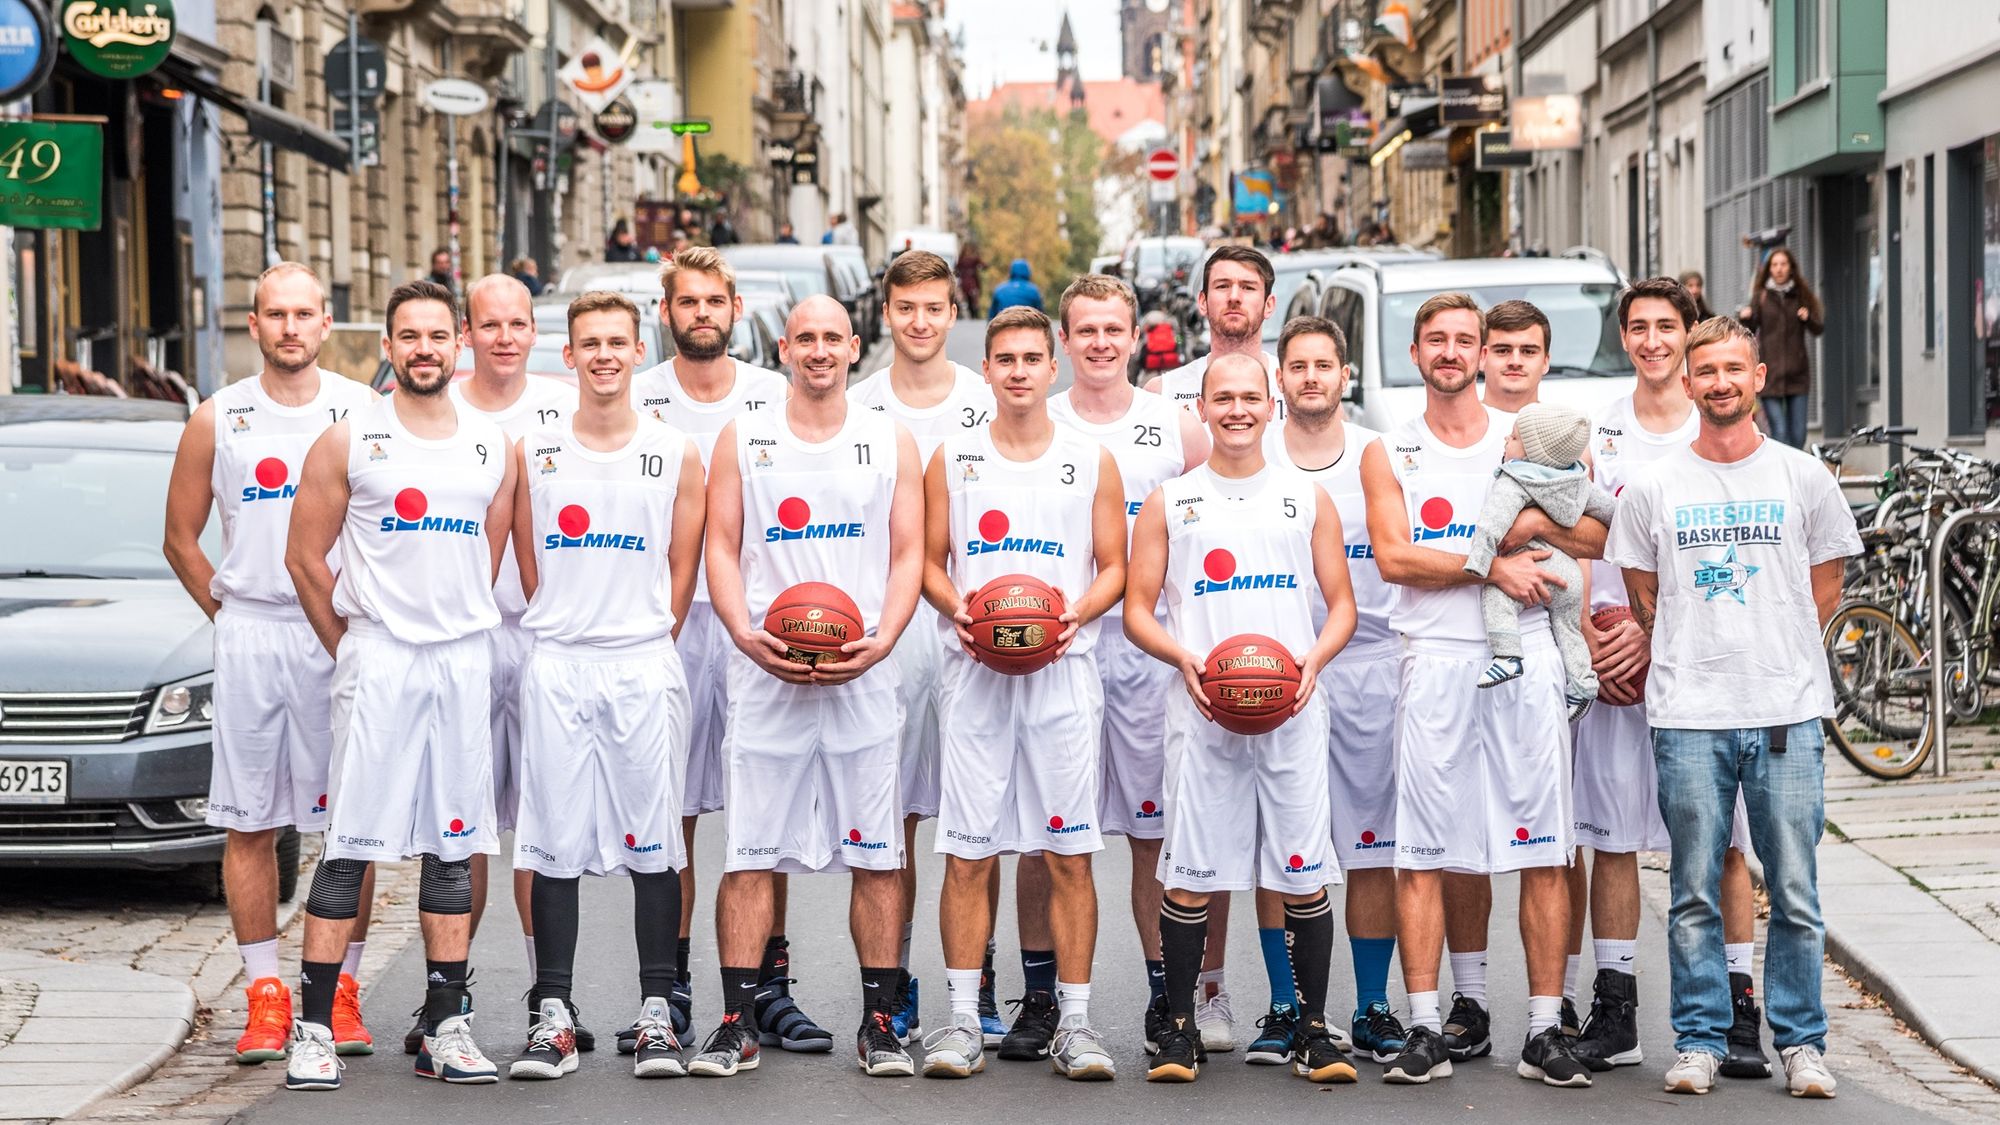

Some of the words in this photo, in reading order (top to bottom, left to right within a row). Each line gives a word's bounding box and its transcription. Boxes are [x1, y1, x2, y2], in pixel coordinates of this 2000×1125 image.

[64, 1, 171, 48] Carlsberg
[1133, 424, 1162, 447] 25
[475, 443, 488, 465] 9
[854, 443, 871, 465] 11
[639, 453, 663, 478] 10
[1060, 463, 1076, 485] 3
[1283, 497, 1297, 519] 5
[1675, 503, 1785, 529] DRESDEN
[1676, 525, 1782, 546] BASKETBALL
[1694, 568, 1733, 586] BC
[983, 596, 1052, 617] SPALDING
[780, 617, 849, 641] SPALDING
[1217, 656, 1285, 675] SPALDING
[1218, 686, 1284, 700] TF-1000
[0, 766, 62, 792] 6913
[348, 837, 385, 847] DRESDEN
[946, 829, 957, 839] BC
[957, 832, 992, 845] DRESDEN
[748, 847, 780, 856] DRESDE
[1411, 846, 1446, 856] DRESDEN
[1175, 865, 1186, 874] BC
